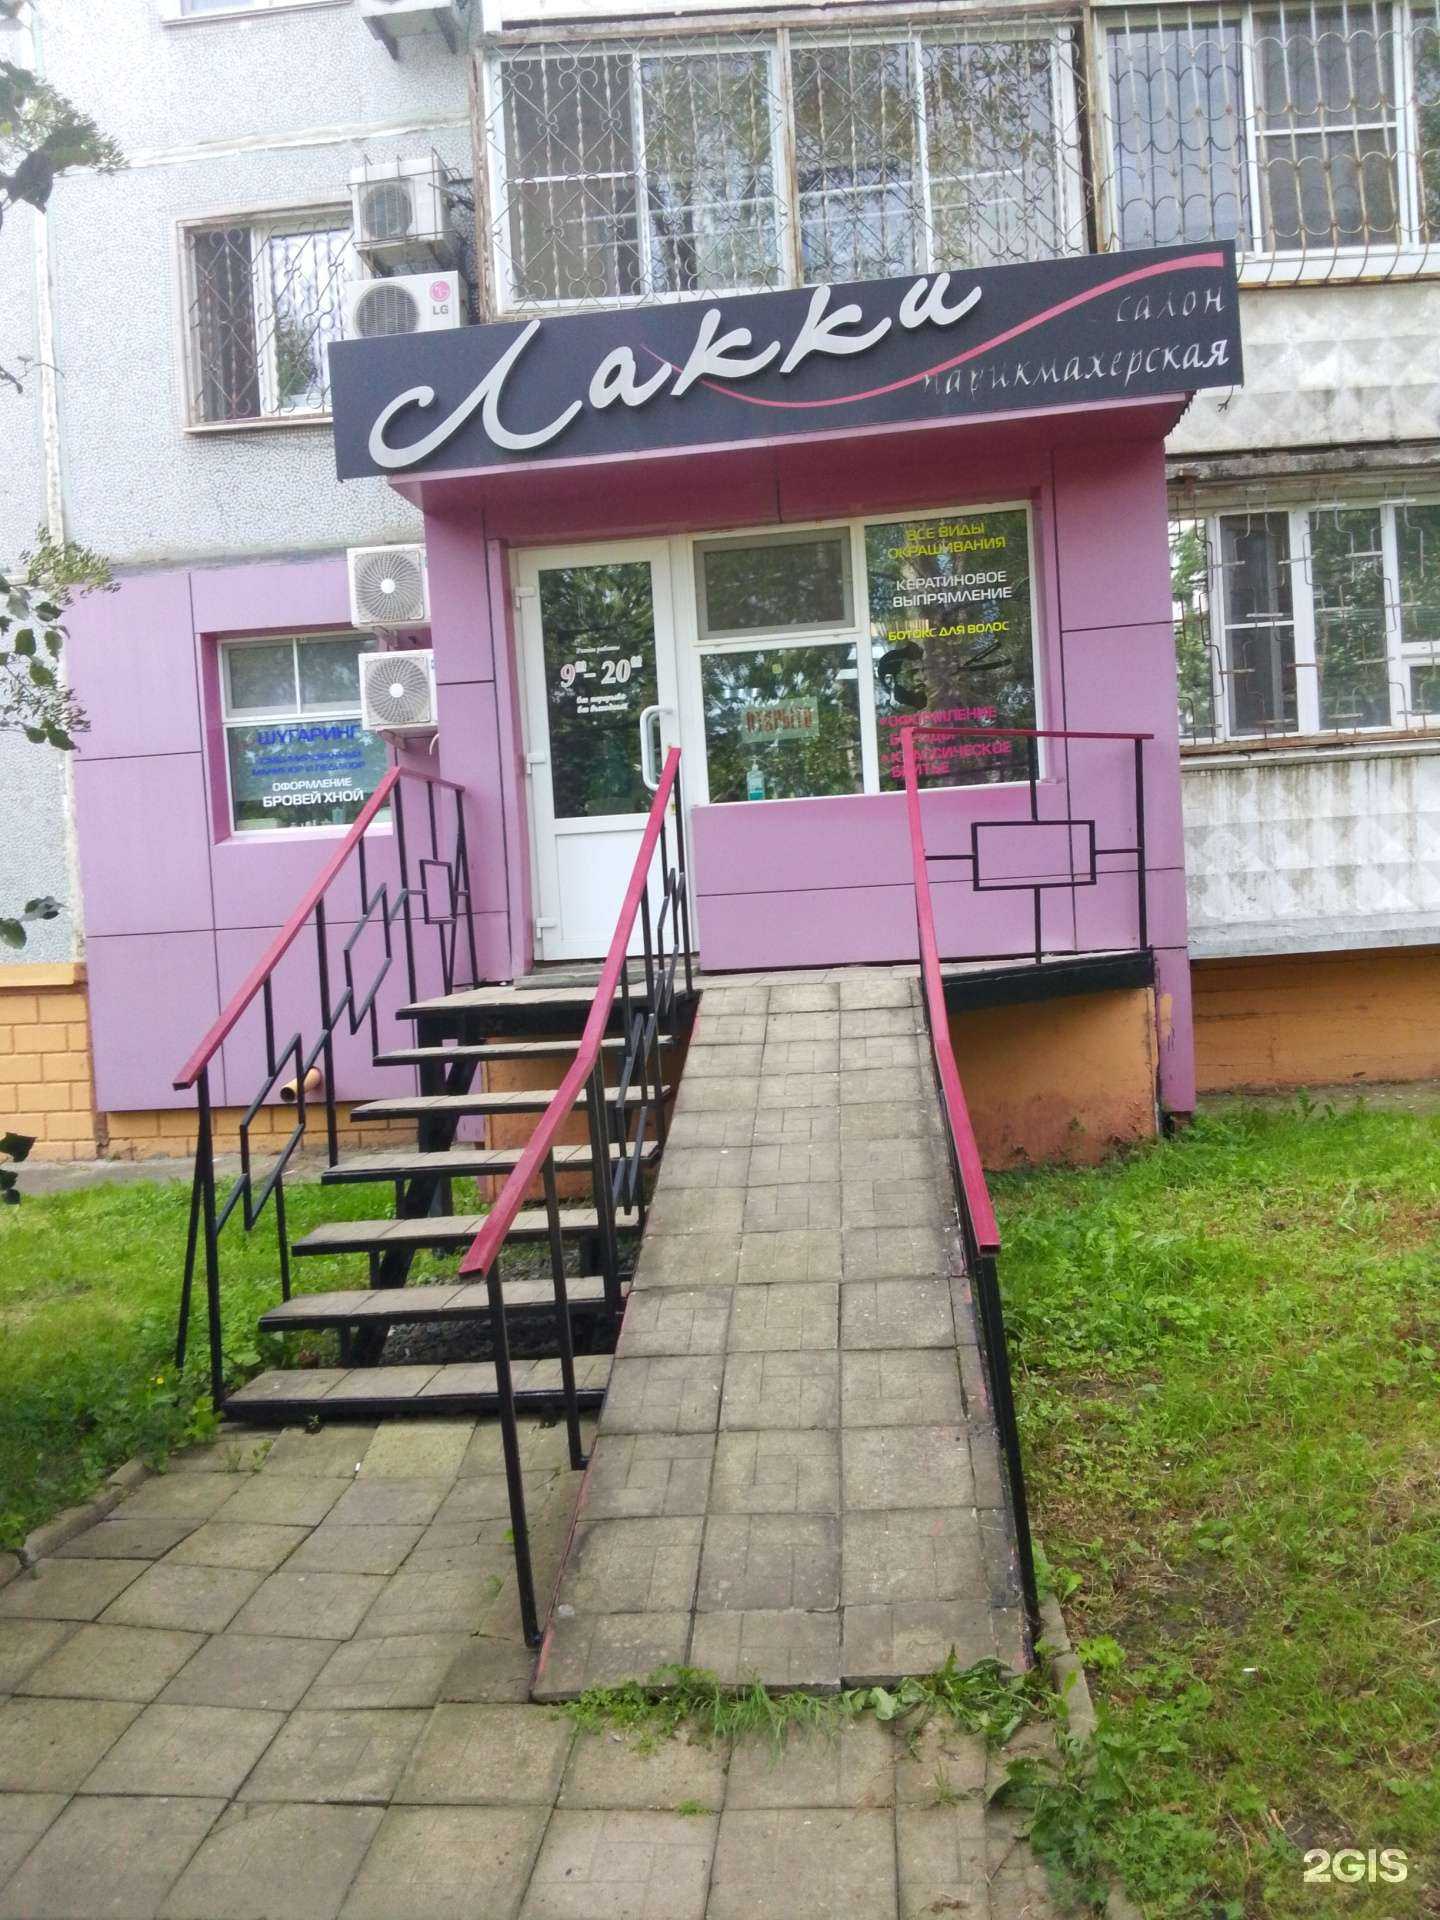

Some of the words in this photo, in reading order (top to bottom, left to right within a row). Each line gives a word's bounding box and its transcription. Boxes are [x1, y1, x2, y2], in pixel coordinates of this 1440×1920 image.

[432, 304, 449, 316] LG
[1116, 286, 1225, 322] салон
[368, 273, 982, 468] Лакки
[906, 527, 935, 541] ВСЕ
[938, 522, 985, 538] ВИДЫ
[888, 536, 1006, 560] ОКРАШИВАНИЯ
[896, 570, 1007, 591] КЕРАТИНОВОЕ
[893, 586, 1012, 608] ВЫПРЯМЛЕНИЕ
[888, 627, 937, 641] БОТОКС
[939, 625, 965, 637] ДЛЯ
[967, 621, 1010, 635] ВОЛОС
[256, 723, 361, 745] ШУГАРИНГ
[891, 740, 1012, 762] КАССИЧЕСКОЕ
[272, 777, 352, 791] ОФОРМЛЕНИЕ
[262, 791, 322, 807] БРОВЕЙ
[324, 788, 364, 803] ХНОЙ
